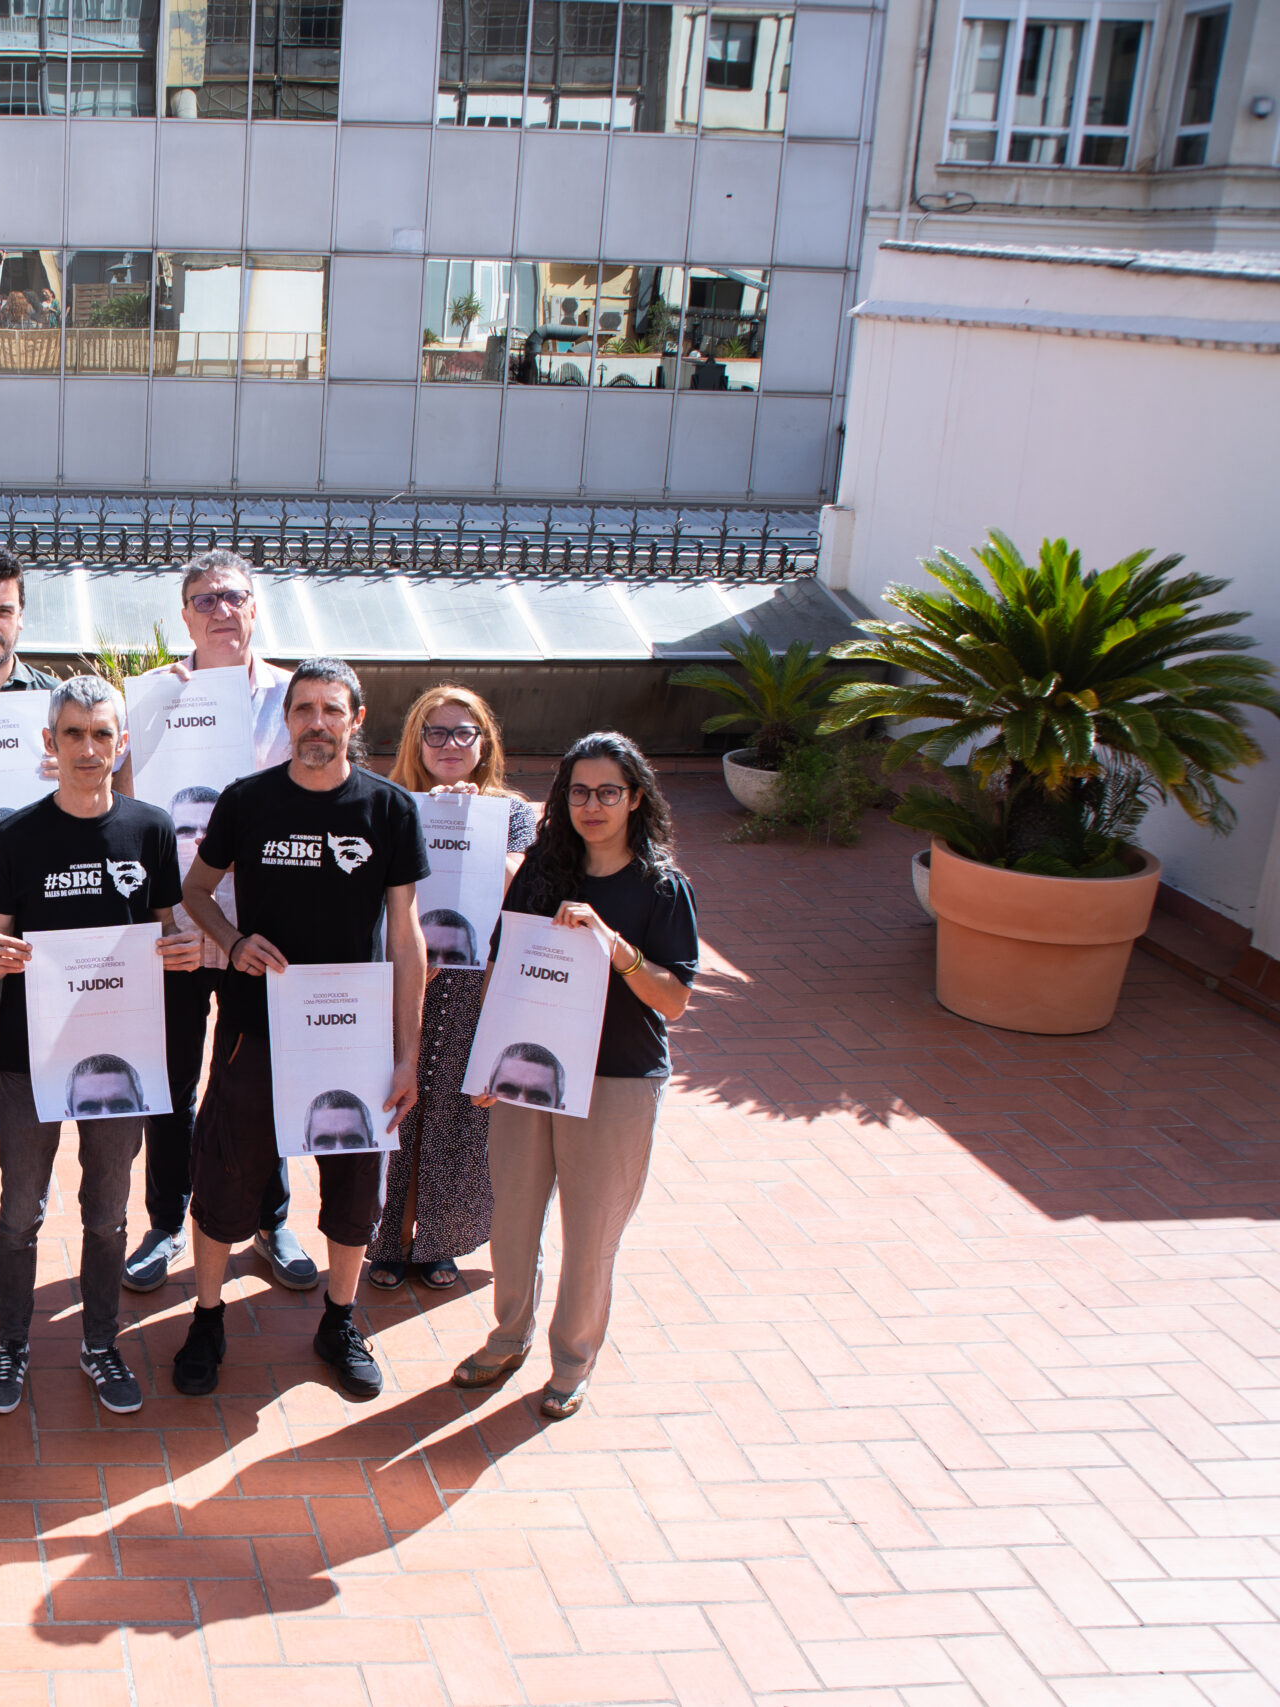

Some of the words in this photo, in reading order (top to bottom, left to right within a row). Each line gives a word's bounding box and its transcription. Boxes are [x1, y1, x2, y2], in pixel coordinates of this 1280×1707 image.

[165, 719, 171, 729] 1
[173, 715, 217, 728] JUDICI
[261, 840, 322, 859] #SBG
[428, 838, 471, 851] JUDICI
[44, 870, 102, 890] #SBG
[60, 889, 68, 897] DE
[520, 963, 526, 975] 1
[525, 965, 569, 984] JUDICI
[68, 981, 74, 992] 1
[76, 976, 124, 992] JUDICI
[306, 1014, 312, 1026] 1
[313, 1013, 357, 1026] JUDICI
